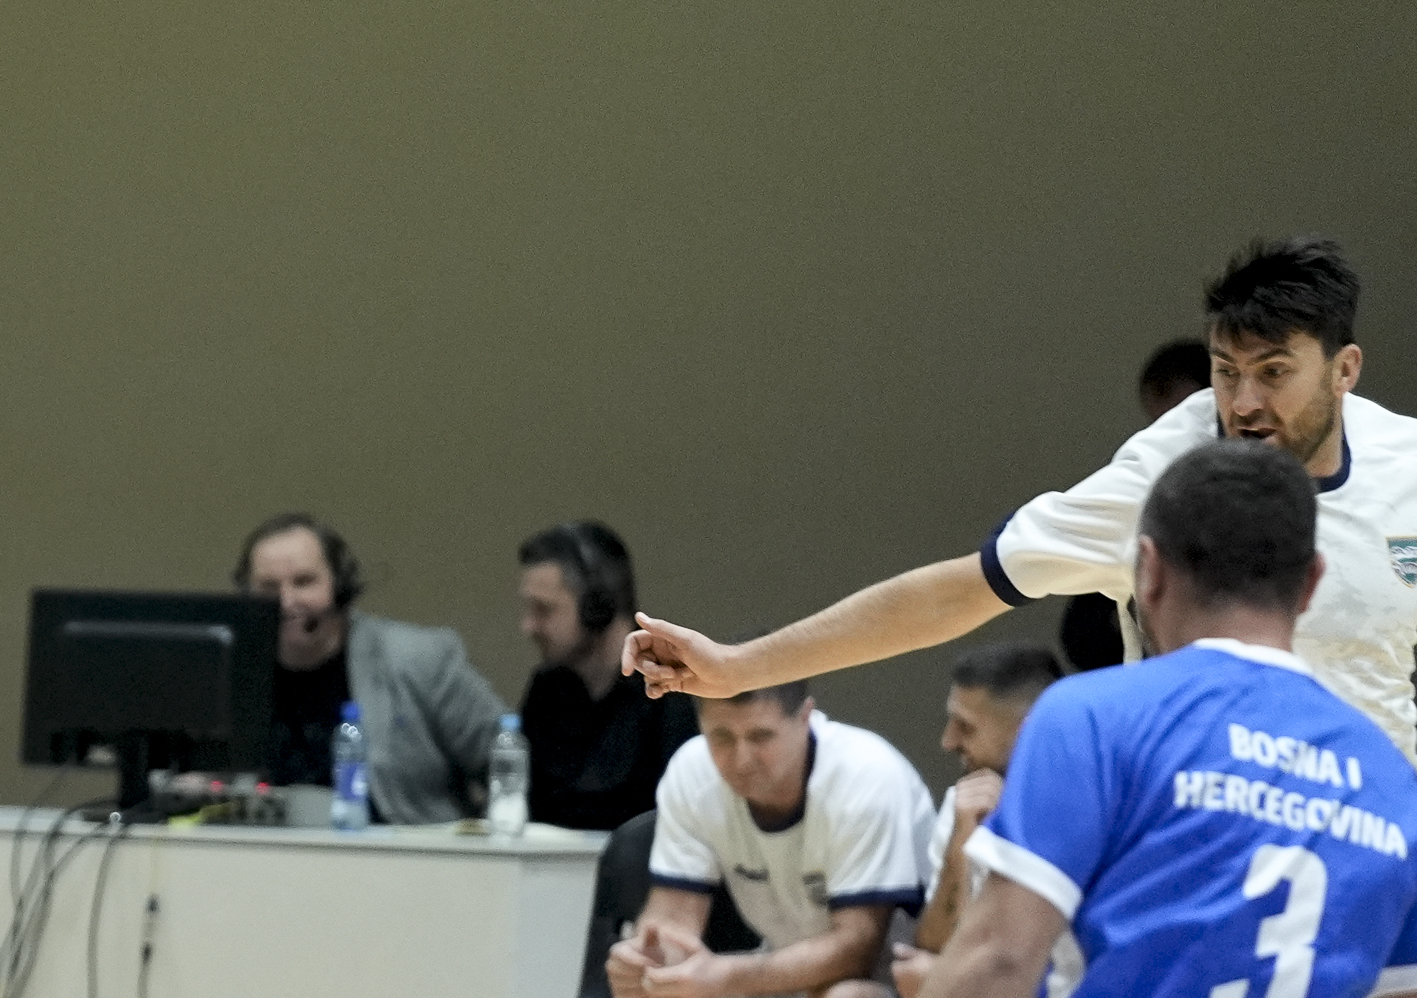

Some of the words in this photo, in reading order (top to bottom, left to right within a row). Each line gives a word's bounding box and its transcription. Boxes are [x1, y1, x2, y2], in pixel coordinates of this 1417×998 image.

[1229, 722, 1344, 788] BOSNA
[1346, 756, 1363, 790] I
[1174, 771, 1408, 860] HERCEGOVINA
